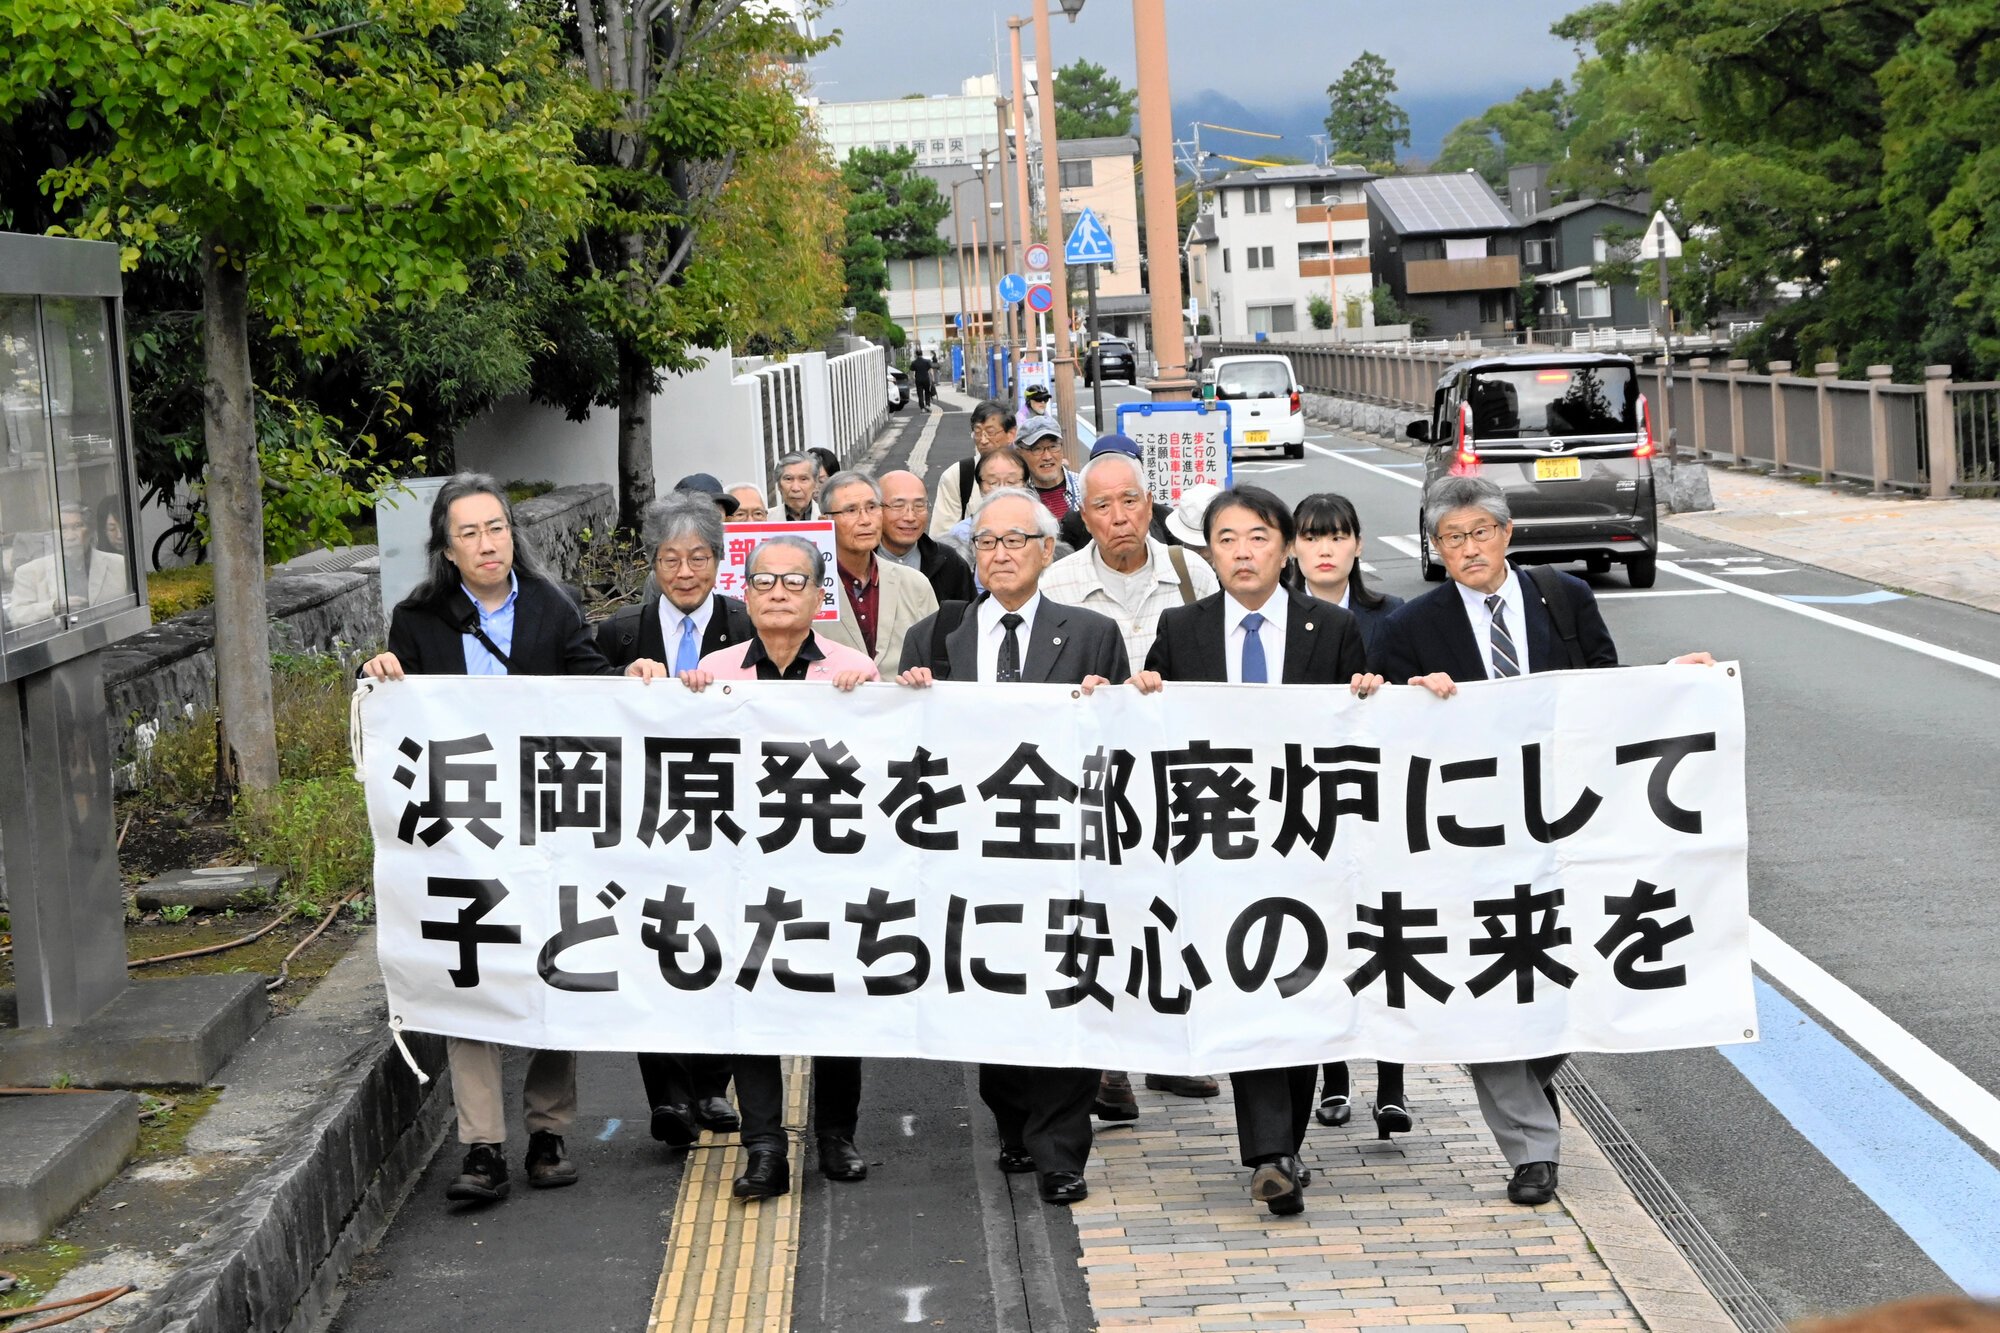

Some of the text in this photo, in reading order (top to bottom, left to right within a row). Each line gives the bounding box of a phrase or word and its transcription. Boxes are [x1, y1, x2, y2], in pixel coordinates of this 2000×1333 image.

[1030, 251, 1045, 265] 30
[1157, 433, 1168, 505] お願いしま
[1182, 432, 1193, 491] 先に進ん
[1194, 432, 1205, 485] 歩行者の
[1206, 432, 1217, 472] この先
[392, 731, 1717, 866] 浜岡原発を全部廃炉にして
[420, 875, 1695, 1016] 子どもたちに安心の未来を
